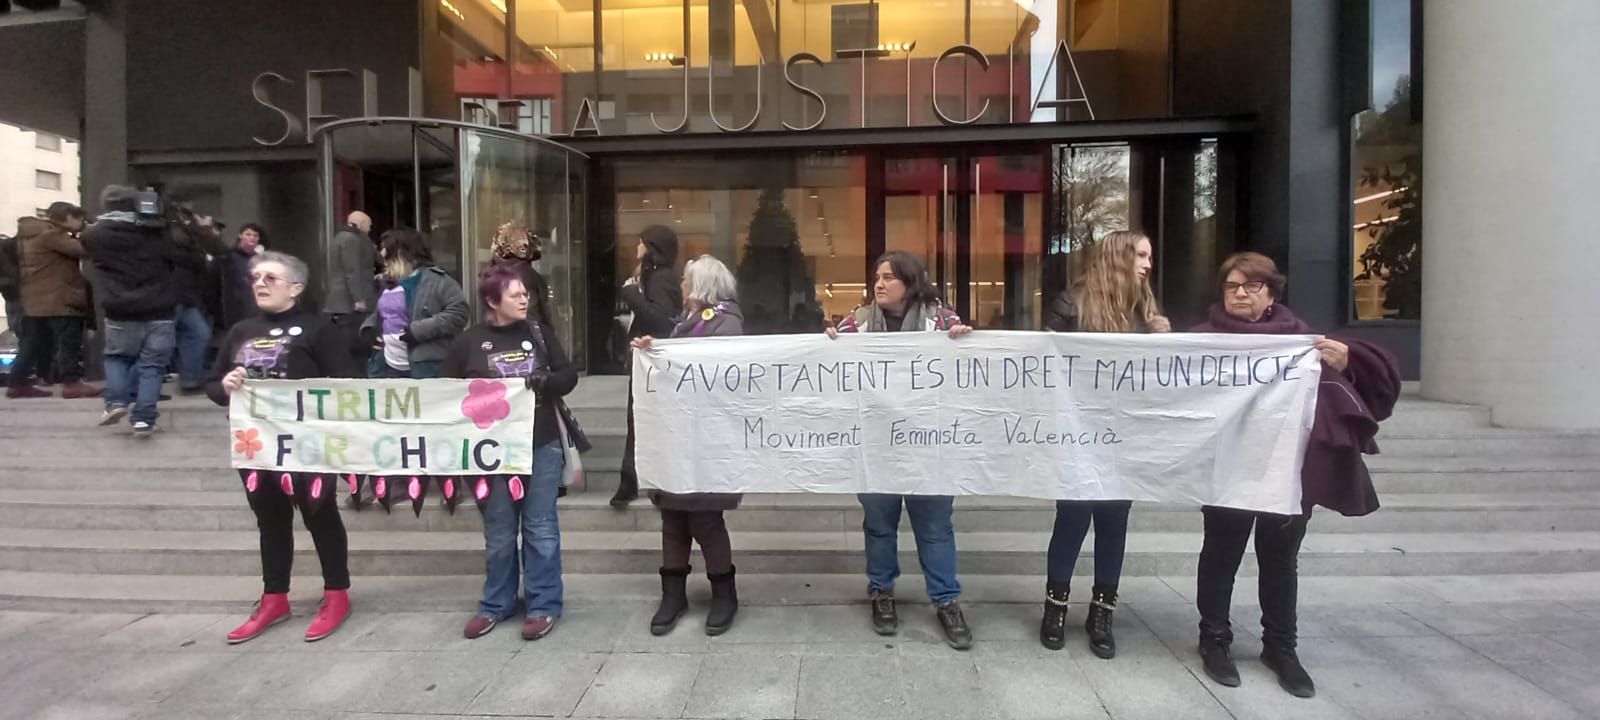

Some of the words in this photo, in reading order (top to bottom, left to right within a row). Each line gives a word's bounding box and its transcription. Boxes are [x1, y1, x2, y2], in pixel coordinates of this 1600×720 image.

[646, 359, 896, 394] L'AVORTAMENT
[910, 354, 944, 391] ÉS
[956, 356, 990, 390] UN
[1003, 354, 1081, 390] DRET
[1094, 357, 1147, 393] MAI
[1156, 354, 1192, 388] UN
[1200, 353, 1306, 387] DELICTE
[249, 385, 421, 422] LEITRIM
[276, 432, 348, 467] FOR
[373, 435, 526, 472] CHOICE
[744, 416, 862, 450] Moviment
[889, 418, 983, 448] Feminista
[1003, 416, 1123, 446] Valencià
